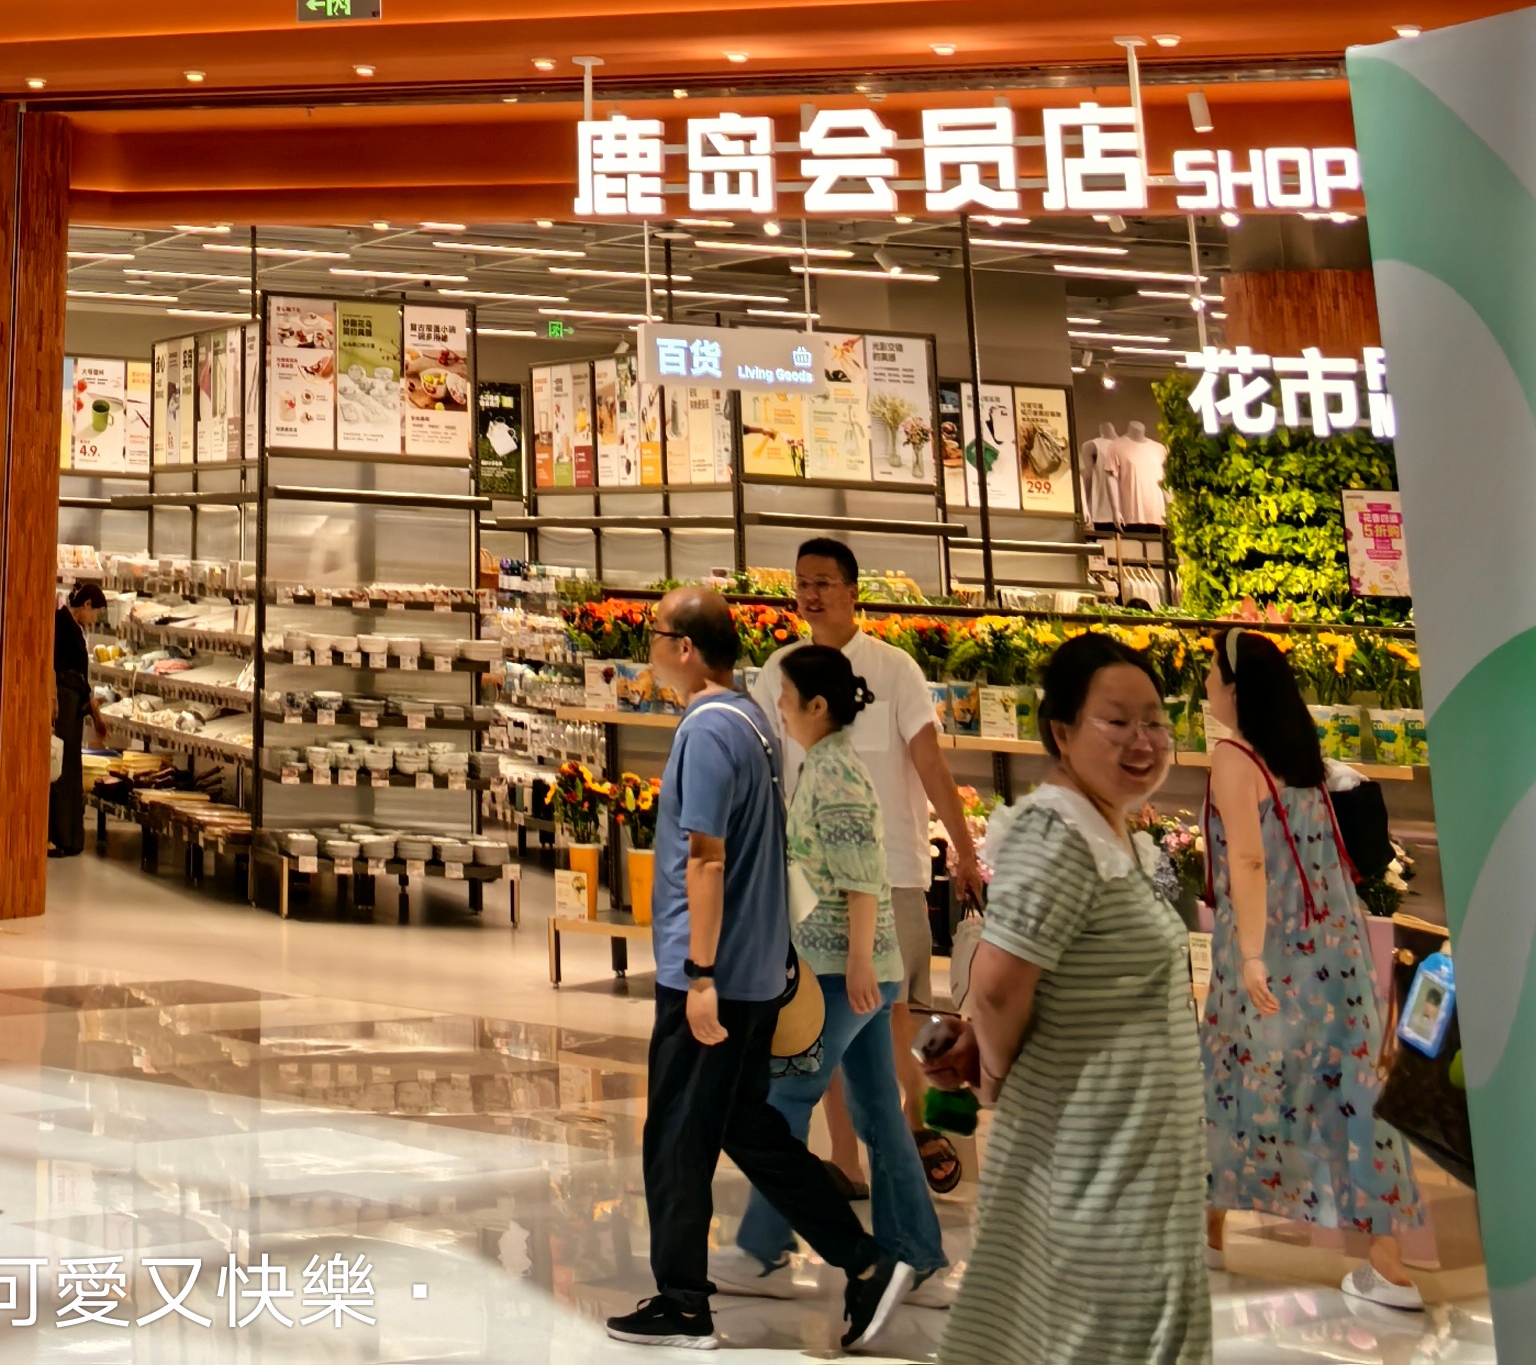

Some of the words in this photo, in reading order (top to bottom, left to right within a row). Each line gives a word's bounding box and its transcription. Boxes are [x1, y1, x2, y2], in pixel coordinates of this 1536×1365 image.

[572, 102, 1150, 216] 鹿岛会员店
[1174, 147, 1360, 210] SHOP
[656, 338, 722, 377] 百货
[738, 365, 774, 383] Living
[776, 368, 813, 383] Goods
[1186, 346, 1357, 437] 花市
